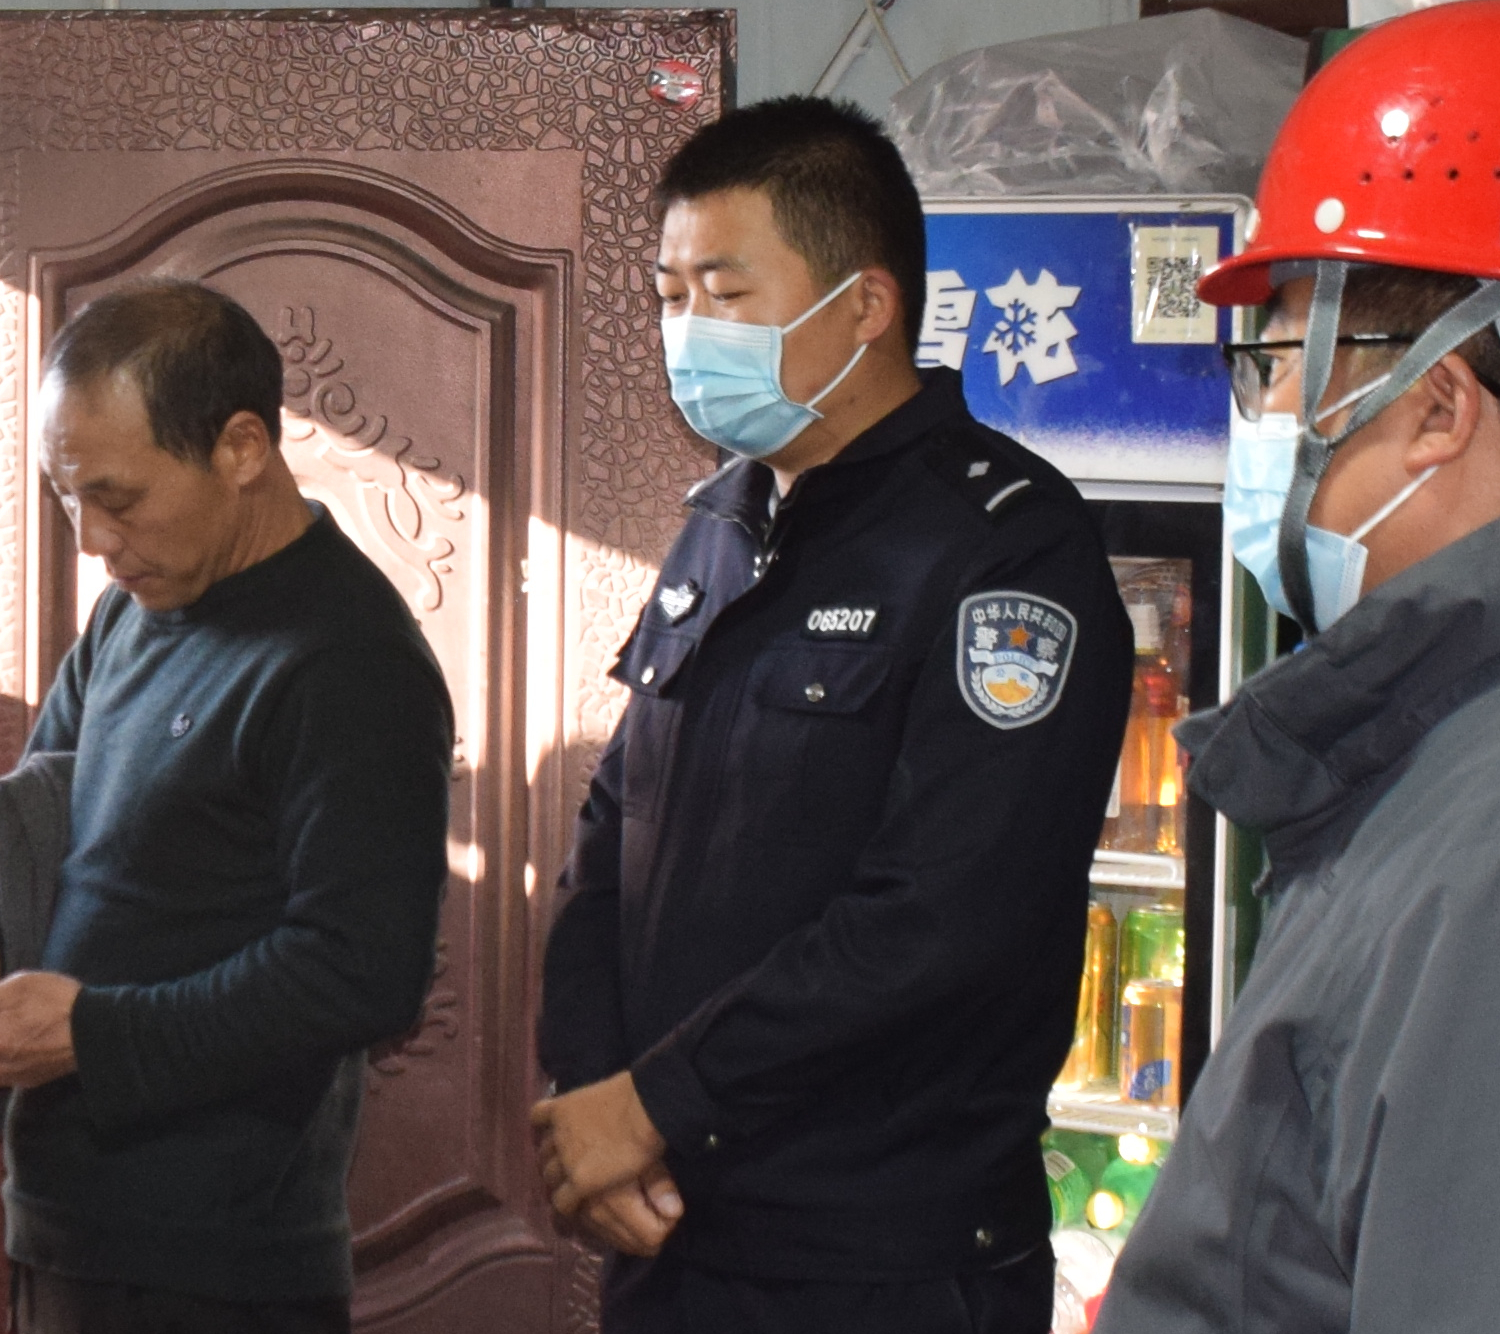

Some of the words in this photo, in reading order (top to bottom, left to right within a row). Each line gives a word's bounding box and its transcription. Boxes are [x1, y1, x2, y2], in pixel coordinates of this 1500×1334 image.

[806, 609, 877, 632] 065207
[971, 602, 1068, 642] 中华人民共和国
